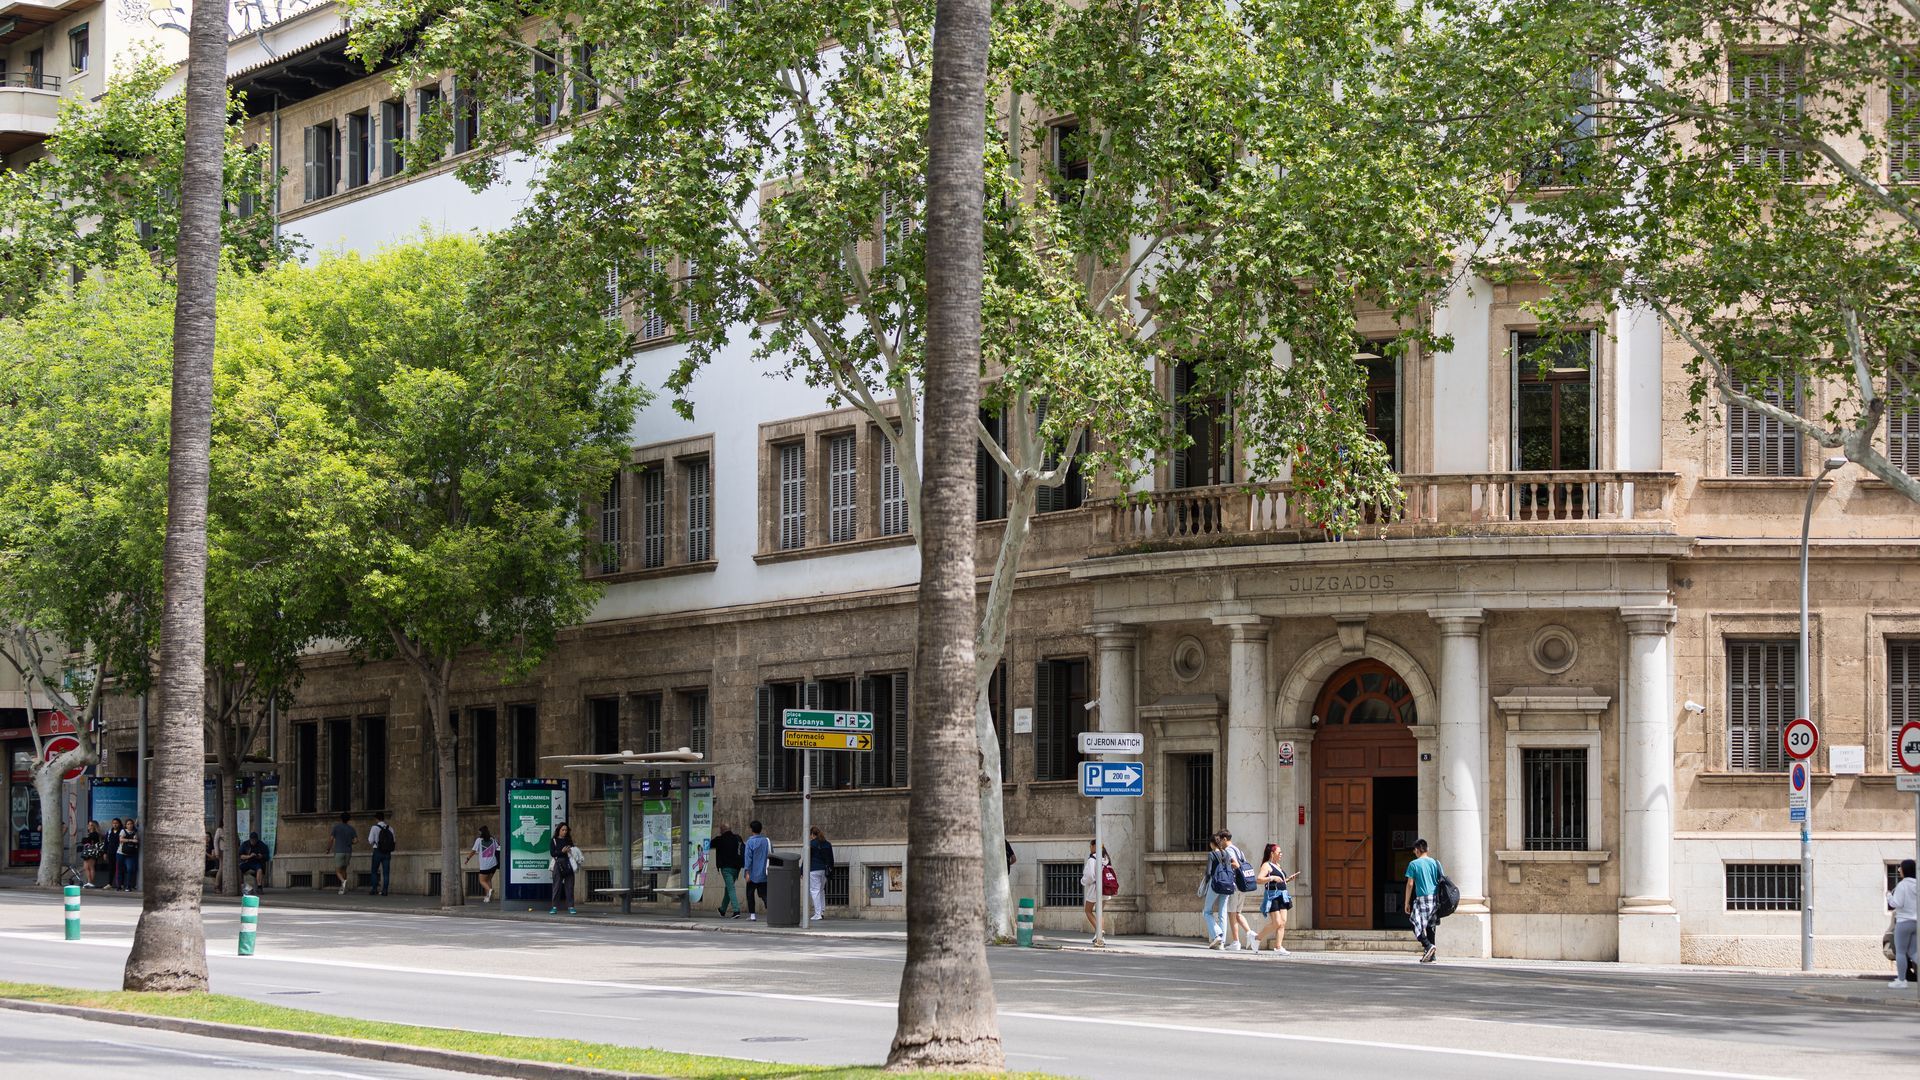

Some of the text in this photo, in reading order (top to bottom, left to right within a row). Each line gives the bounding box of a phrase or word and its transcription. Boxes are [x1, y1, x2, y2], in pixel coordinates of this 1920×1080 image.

[1289, 574, 1394, 592] JUZGADOS
[786, 718, 824, 727] d'Espanya
[1086, 738, 1140, 747] C/ JERONI ANTICH
[1791, 733, 1810, 746] 30
[1089, 767, 1100, 785] P
[1112, 772, 1123, 780] 200
